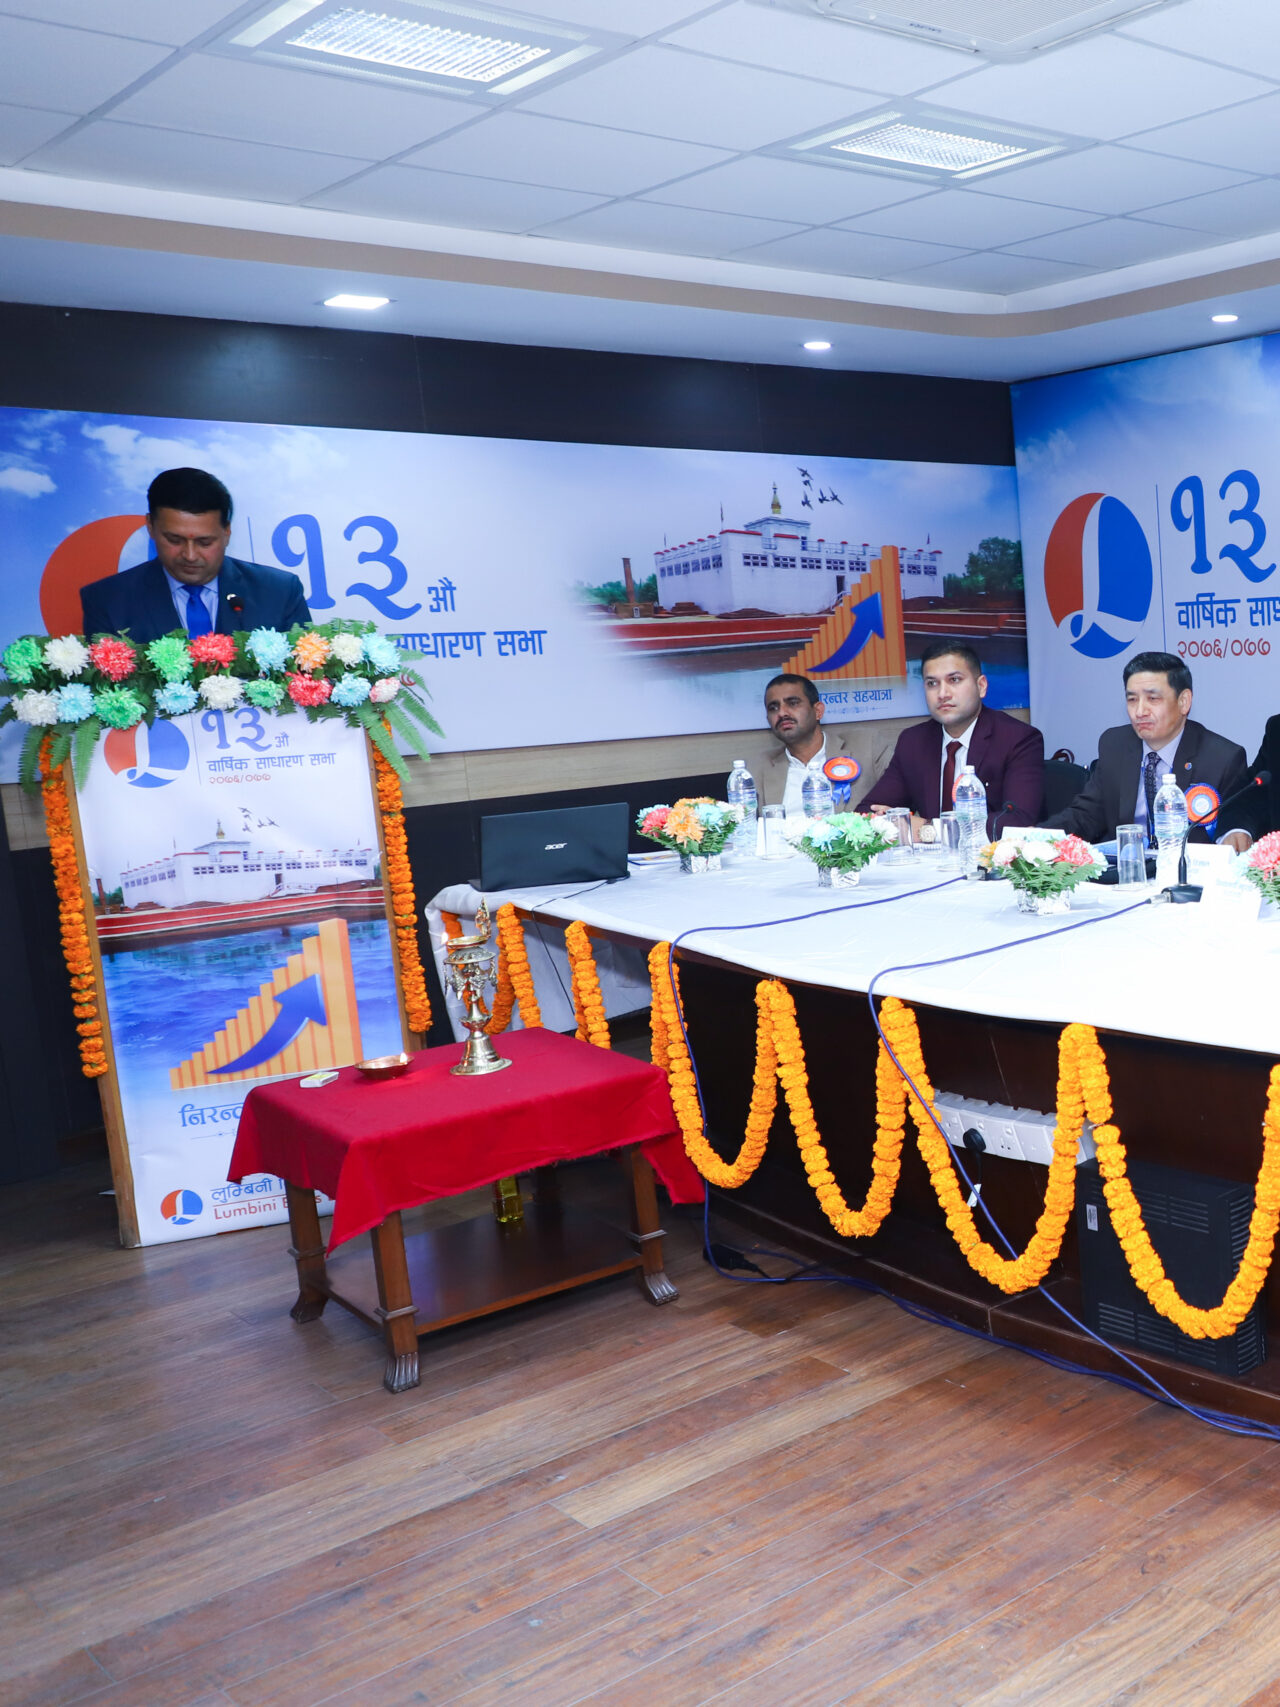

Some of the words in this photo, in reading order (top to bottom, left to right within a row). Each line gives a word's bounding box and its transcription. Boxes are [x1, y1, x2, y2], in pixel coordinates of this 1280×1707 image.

[1170, 469, 1276, 583] १३
[271, 514, 422, 620] १३
[1175, 592, 1241, 629] वार्षिक
[493, 630, 548, 656] सभा
[1177, 638, 1271, 659] २०७६/०७७
[852, 689, 893, 703] सहयात्रा
[201, 707, 272, 752] १३
[206, 756, 250, 772] वार्षिक
[254, 755, 304, 769] साधारण
[309, 752, 336, 766] सभा
[209, 773, 271, 784] २०७६/०७७
[214, 1199, 277, 1220] Lumbini
